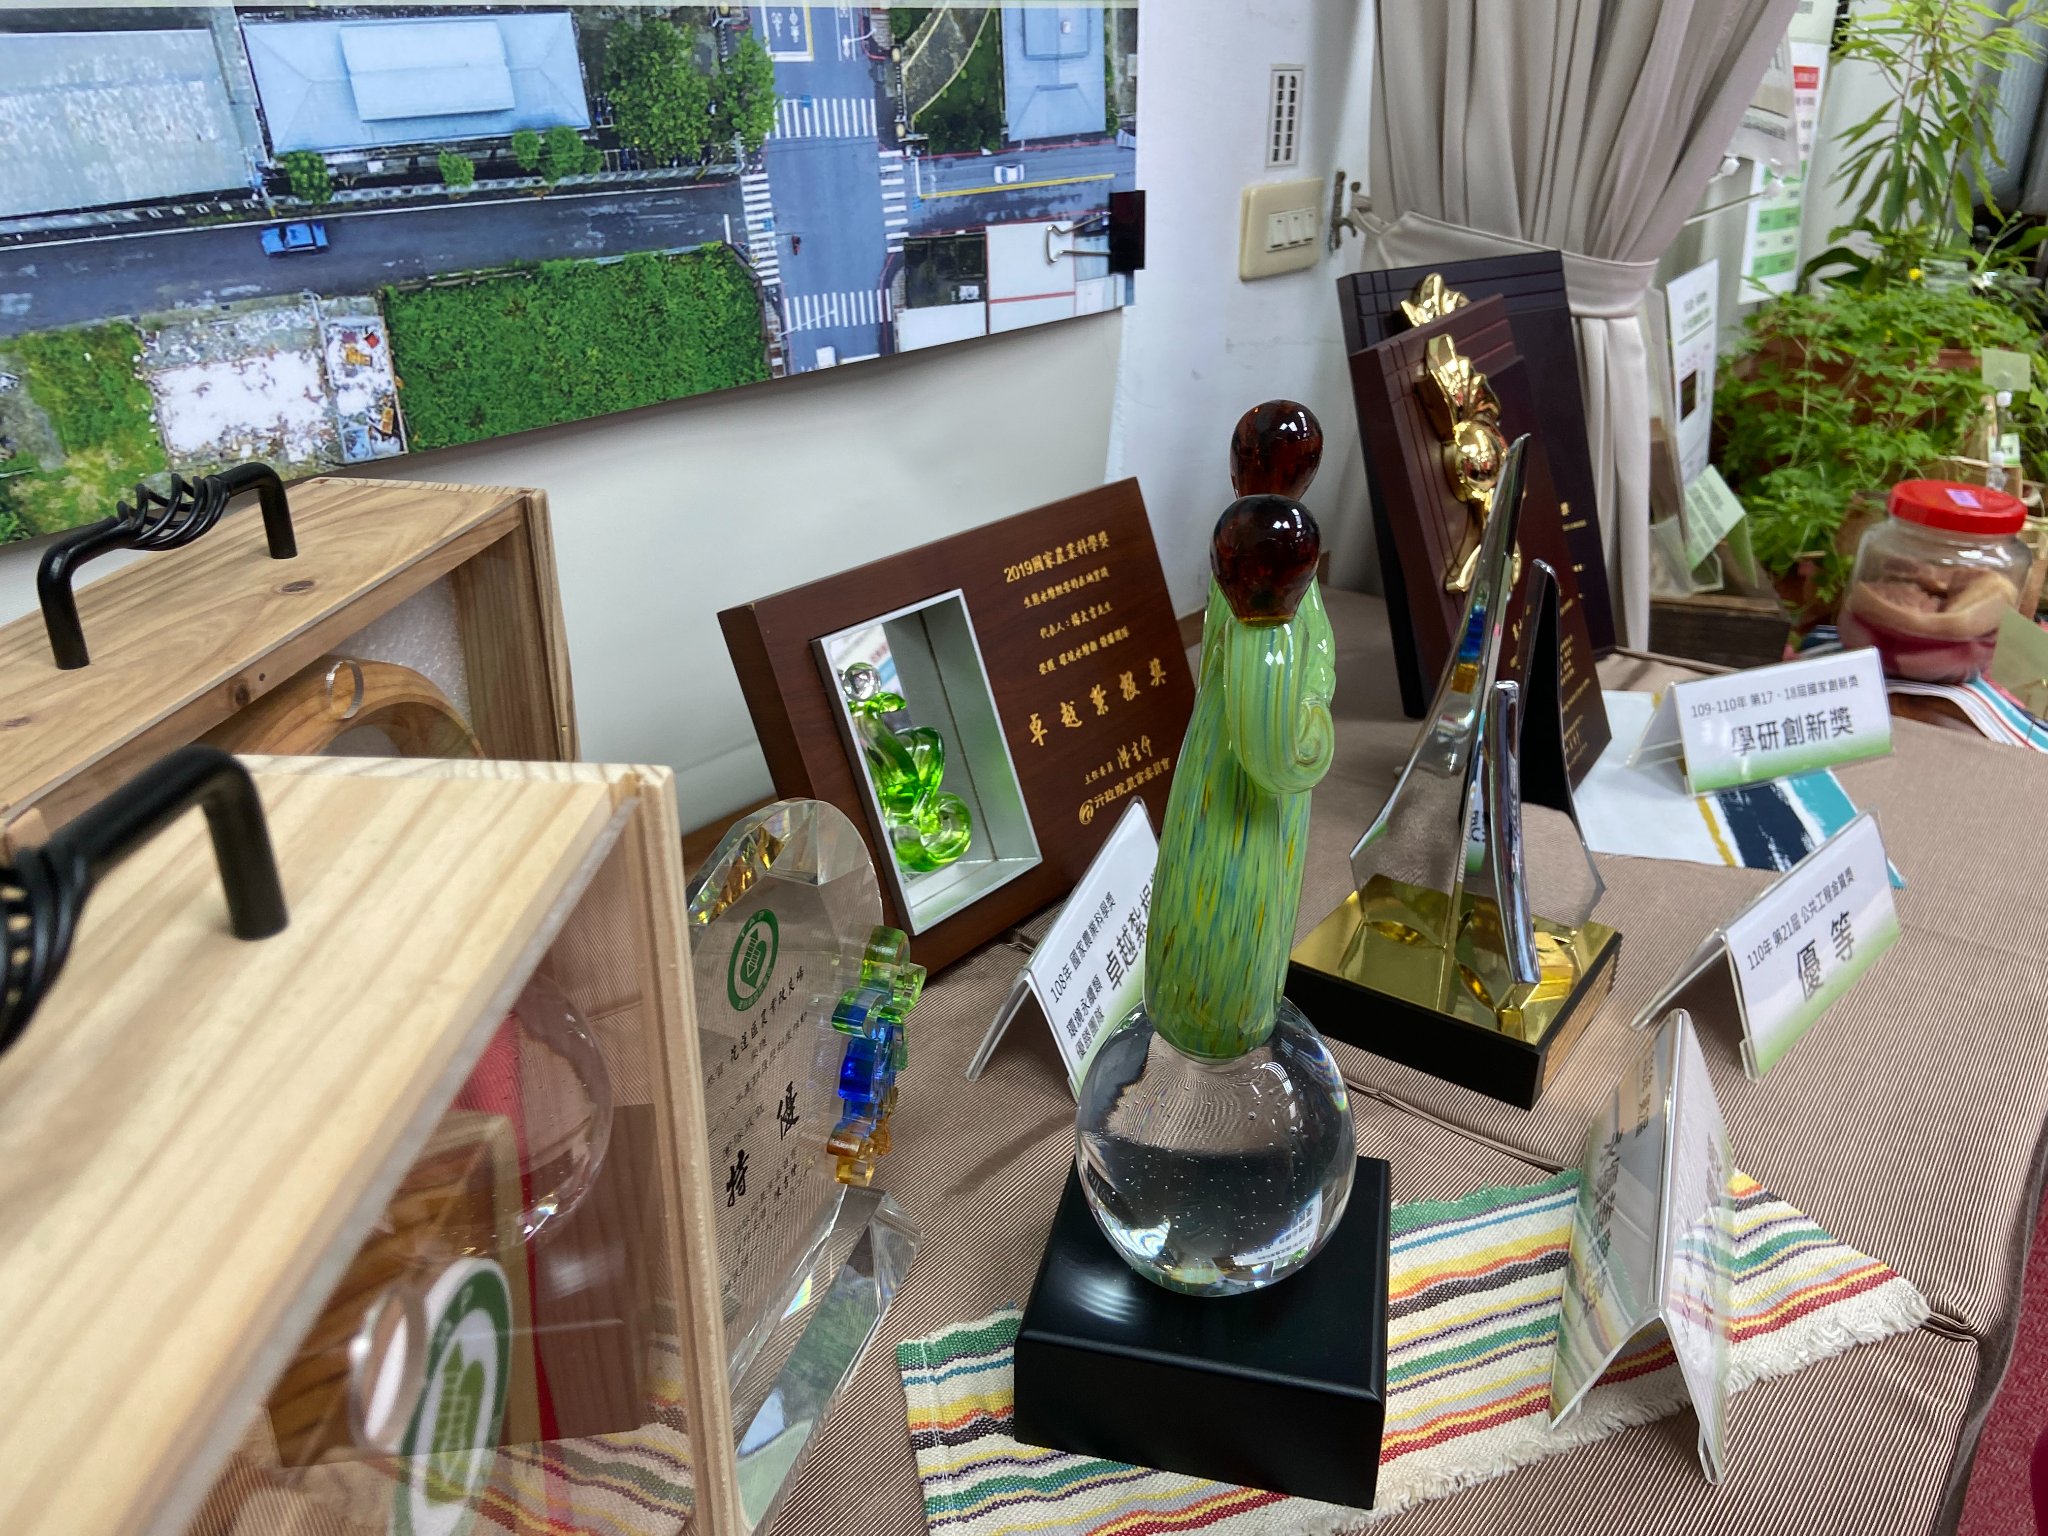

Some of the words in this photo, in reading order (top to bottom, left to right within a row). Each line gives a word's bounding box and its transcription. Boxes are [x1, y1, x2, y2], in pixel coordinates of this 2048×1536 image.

[1004, 530, 1110, 583] 2019國家農業科學獎
[1691, 696, 1748, 719] 109-110年
[1731, 706, 1855, 757] 學研創新獎
[1050, 962, 1074, 1004] 108年
[1069, 890, 1117, 971] 國家農業科學獎
[1105, 873, 1155, 991] 卓越紮根
[1746, 938, 1774, 971] 110年
[1771, 914, 1802, 946] 第21屆
[1796, 911, 1855, 1002] 優等
[1066, 974, 1104, 1040] 環境永續類
